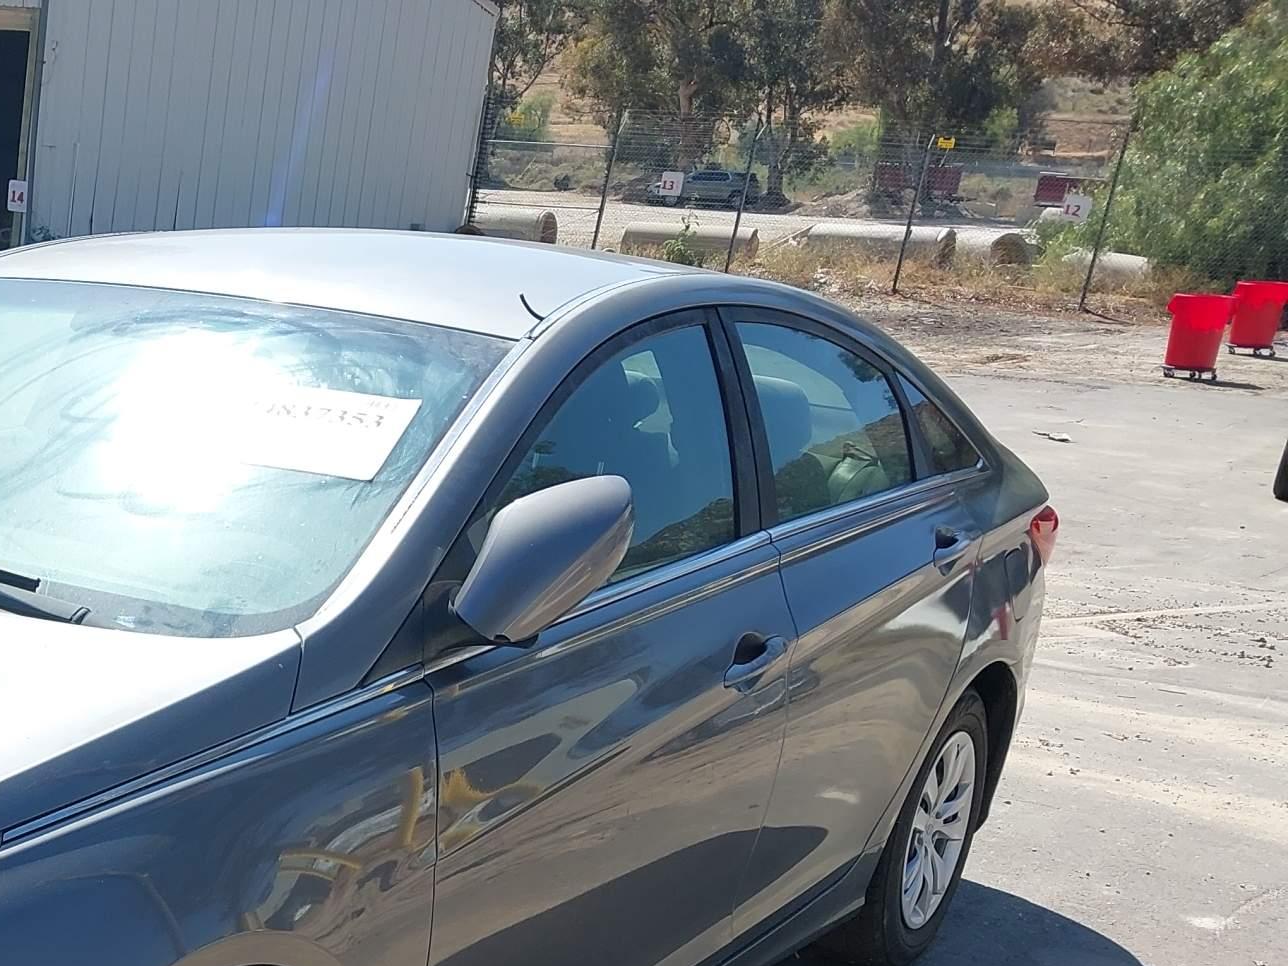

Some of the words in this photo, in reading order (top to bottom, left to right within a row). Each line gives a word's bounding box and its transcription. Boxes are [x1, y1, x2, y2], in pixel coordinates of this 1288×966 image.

[661, 180, 674, 191] 13
[11, 190, 25, 203] 14
[1064, 204, 1081, 217] 12
